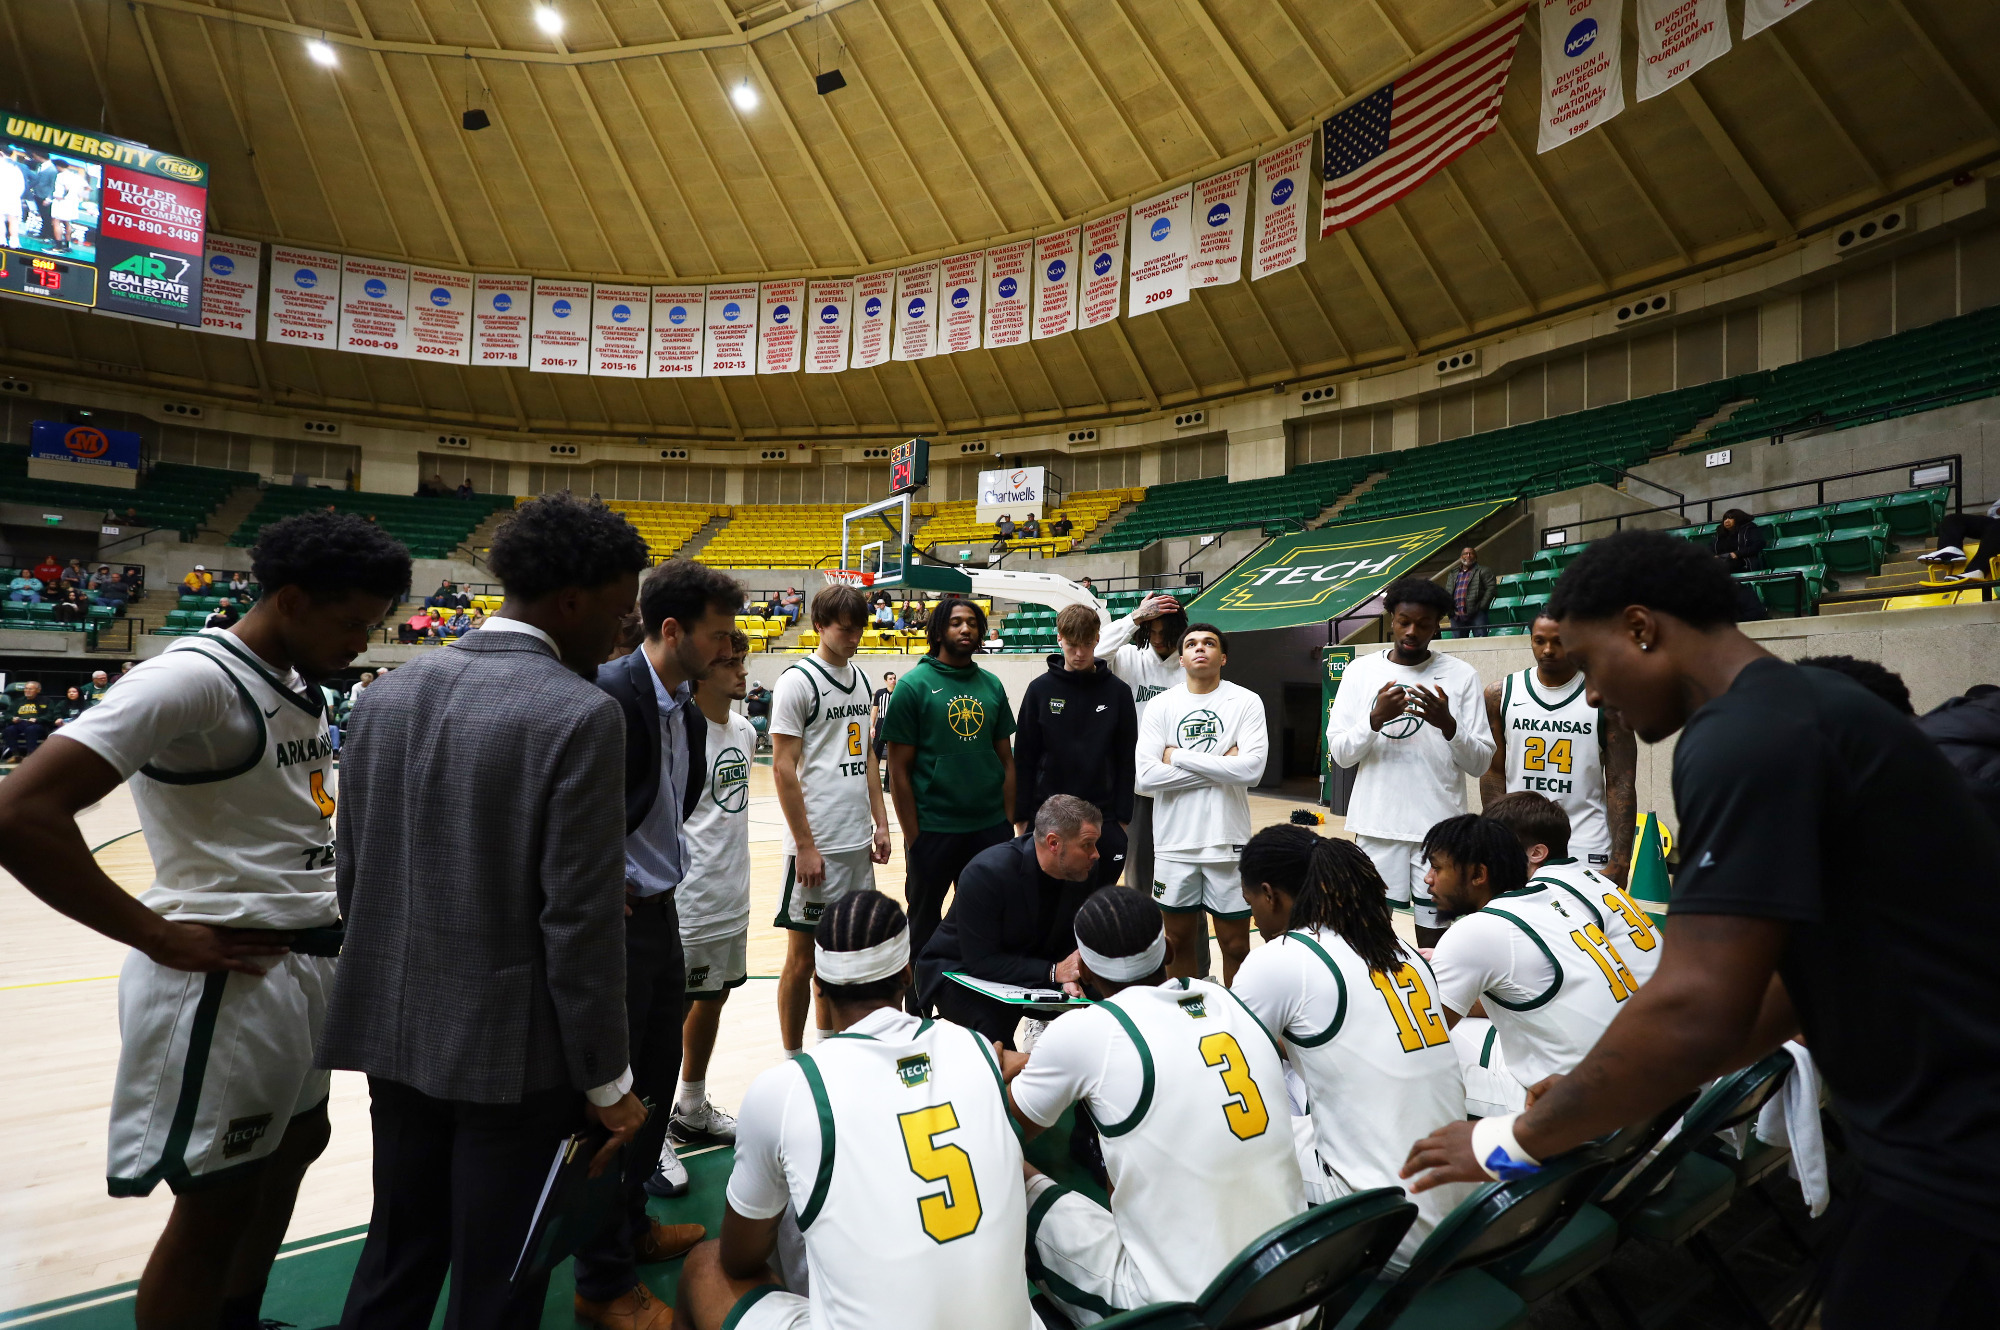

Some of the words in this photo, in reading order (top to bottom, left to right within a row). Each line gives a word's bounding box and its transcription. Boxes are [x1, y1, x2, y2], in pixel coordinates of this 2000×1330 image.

[1655, 0, 1698, 31] DIVISION
[1664, 9, 1696, 36] SOUTH
[1567, 28, 1597, 53] NCAA
[1661, 19, 1699, 49] REGION
[1647, 21, 1714, 66] TOURNAMENT
[1557, 57, 1596, 85] DIVISION
[1598, 51, 1604, 61] II
[1666, 59, 1691, 79] 2001
[1551, 81, 1573, 98] WEST
[1576, 60, 1610, 84] REGION
[1570, 82, 1590, 98] AND
[1550, 88, 1607, 127] TOURNAMENT
[1557, 85, 1602, 114] NATIONAL
[6, 117, 154, 168] UNIVERSITY
[1258, 146, 1293, 168] ARKANSAS
[1294, 138, 1311, 150] TECH
[1265, 151, 1304, 173] UNIVERSITY
[163, 158, 198, 177] TECH
[1267, 164, 1300, 182] FOOTBALL
[1196, 174, 1231, 191] ARKANSAS
[1233, 166, 1249, 177] TECH
[107, 178, 177, 205] MILLER
[1203, 179, 1240, 197] UNIVERSITY
[1272, 185, 1292, 200] NCAA
[120, 191, 203, 219] ROOFING
[1134, 199, 1169, 216] ARKANSAS
[1172, 191, 1189, 202] TECH
[1204, 190, 1237, 205] FOOTBALL
[141, 207, 201, 228] COMPANY
[1144, 203, 1179, 219] FOOTBALL
[1209, 213, 1230, 222] NCAA
[1265, 206, 1291, 222] DIVISION
[1293, 203, 1296, 211] II
[107, 214, 199, 243] 479-890-3499
[1265, 212, 1295, 229] NATIONAL
[1265, 220, 1295, 237] PLAYOFFS
[1036, 232, 1065, 246] ARKANSAS
[1066, 227, 1079, 237] TECH
[1152, 227, 1170, 237] NCAA
[1201, 231, 1229, 241] DIVISION
[1260, 235, 1276, 246] GULF
[1277, 227, 1298, 239] SOUTH
[988, 246, 1017, 257] ARKANSAS
[1018, 243, 1031, 251] TECH
[1200, 244, 1230, 254] PLAYOFFS
[1201, 237, 1231, 247] NATIONAL
[1259, 234, 1297, 253] CONFERENCE
[276, 251, 317, 262] ARKANSAS
[993, 252, 1025, 263] UNIVERSITY
[1041, 247, 1074, 260] BASKETBALL
[1144, 254, 1170, 267] DIVISION
[1259, 247, 1296, 265] CHAMPIONS
[111, 255, 167, 280] AR
[346, 261, 386, 271] ARKANSAS
[1131, 264, 1159, 277] NATIONAL
[1191, 261, 1213, 270] SECOND
[1215, 256, 1237, 265] ROUND
[34, 269, 61, 290] 73
[414, 271, 451, 280] ARKANSAS
[1136, 271, 1160, 282] SECOND
[1162, 263, 1183, 274] ROUND
[24, 286, 50, 296] BONUS
[109, 271, 142, 286] REAL
[144, 278, 189, 295] ESTATE
[108, 282, 189, 303] COLLECTIVE
[128, 293, 159, 303] WETZEL
[161, 299, 188, 308] GROUP
[1145, 288, 1172, 304] 2009
[280, 328, 324, 341] 2012-13
[349, 338, 398, 350] 2008-09
[416, 345, 459, 357] 2020-21
[483, 352, 518, 360] 2017-18
[541, 358, 577, 366] 2016-17
[713, 361, 745, 369] 2012-13
[601, 362, 636, 371] 2015-16
[39, 452, 73, 461] METCALF
[77, 457, 112, 466] TRUCKING
[893, 461, 910, 490] 24
[984, 487, 1035, 504] Chartwells
[1252, 553, 1400, 586] TECH
[1329, 662, 1347, 671] TECH
[826, 704, 870, 720] ARKANSAS
[1185, 721, 1215, 736] TECH
[1512, 718, 1592, 735] ARKANSAS
[847, 722, 862, 756] 2
[1524, 736, 1573, 774] 24
[721, 766, 746, 781] TECH
[1522, 775, 1572, 794] TECH
[805, 907, 825, 915] TECH
[1569, 923, 1639, 1003] 13
[689, 972, 708, 980] TECH
[1182, 1001, 1205, 1012] TECH
[1369, 962, 1450, 1053] 12
[898, 1062, 930, 1079] TECH
[1198, 1031, 1270, 1142] 3
[226, 1126, 264, 1144] TECH
[897, 1101, 983, 1245] 5
